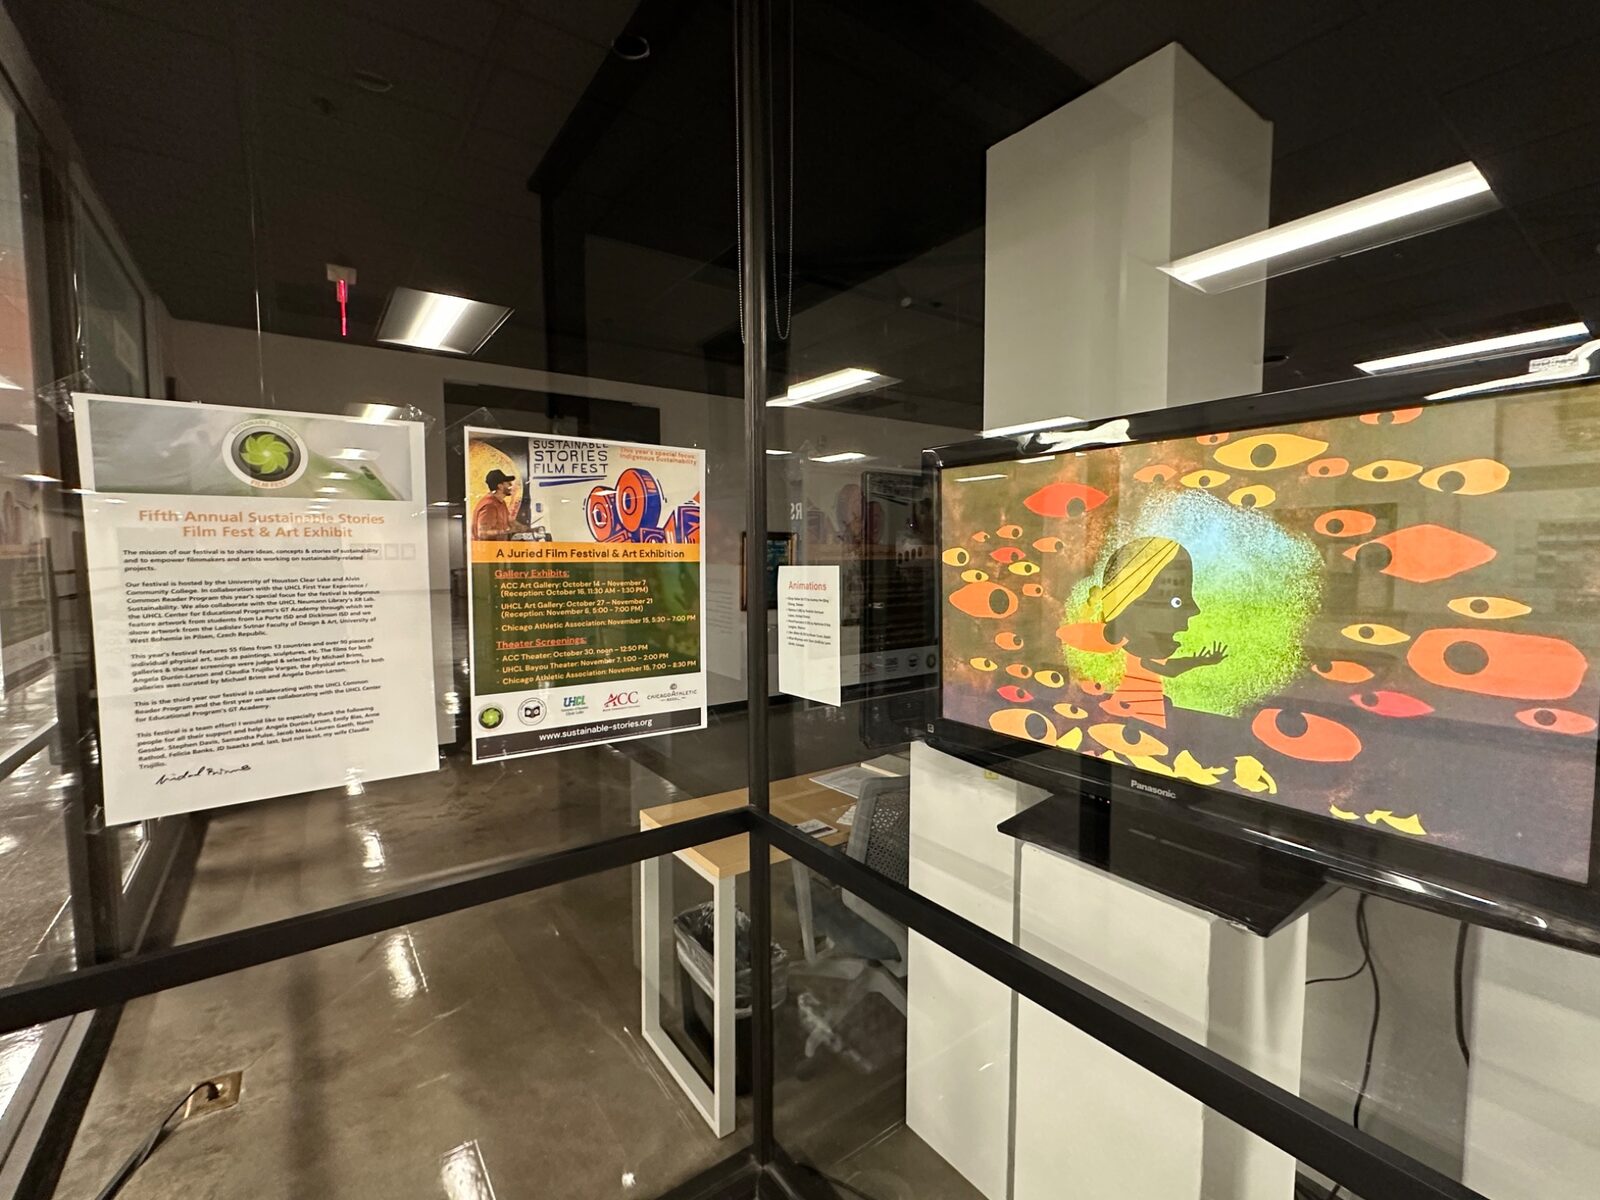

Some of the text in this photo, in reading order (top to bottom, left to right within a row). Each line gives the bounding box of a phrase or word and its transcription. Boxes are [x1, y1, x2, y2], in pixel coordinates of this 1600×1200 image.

[534, 450, 608, 462] STORIES
[656, 456, 696, 465] Sustainability
[533, 463, 608, 474] FILM FEST
[139, 510, 384, 524] Fifth Annual Sustainable Stories
[182, 526, 352, 538] Film Fest & Art Exhibit
[496, 550, 504, 558] A
[507, 549, 542, 558] Juried
[546, 549, 567, 558] Film
[570, 549, 609, 558] Festival
[640, 550, 684, 558] Exhibition
[495, 570, 570, 579] Gallery Exhibits:
[534, 582, 561, 590] Gallery:
[788, 581, 827, 590] Animations
[537, 602, 565, 610] Gallery:
[502, 624, 532, 632] Chicago
[535, 622, 563, 630] Athletic
[564, 620, 606, 628] Association:
[496, 640, 532, 649] Theater
[521, 652, 551, 660] Theater:
[525, 664, 548, 672] Bayou
[580, 658, 614, 666] November
[503, 676, 534, 685] Chicago
[536, 674, 564, 682] Athletic
[566, 670, 606, 680] Association:
[608, 666, 642, 674] November
[564, 696, 586, 707] UHCL
[604, 691, 638, 708] ACC
[539, 718, 652, 741] www.sustainable-stories.org
[1130, 780, 1176, 798] Panasonic
